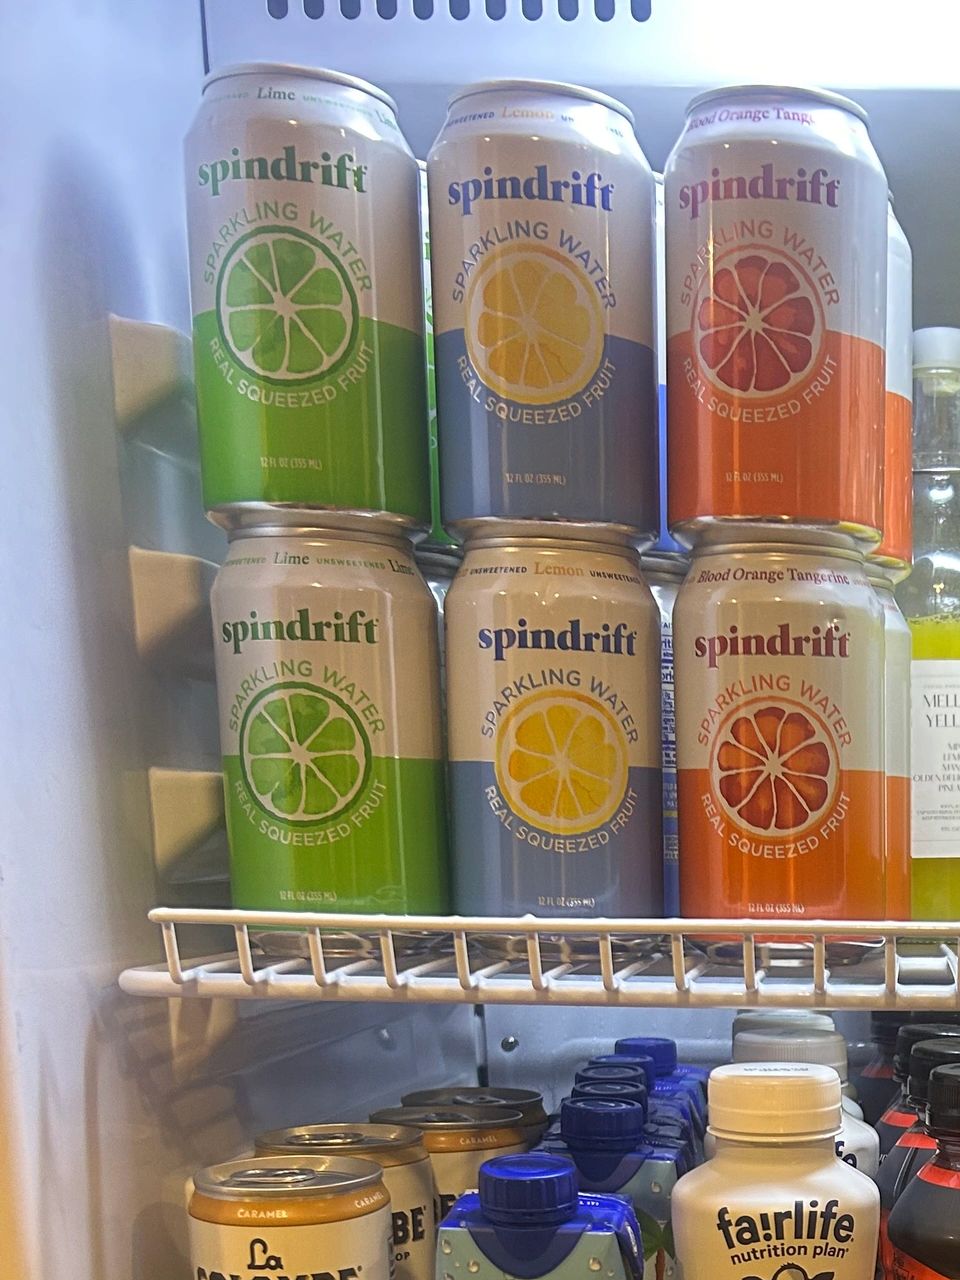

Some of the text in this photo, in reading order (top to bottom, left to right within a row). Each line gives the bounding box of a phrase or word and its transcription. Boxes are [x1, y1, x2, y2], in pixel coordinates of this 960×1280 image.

[257, 86, 296, 102] Lime
[501, 105, 555, 121] Lemon
[717, 107, 771, 124] Orange
[197, 144, 368, 196] spindrift
[448, 165, 615, 217] spindrift
[679, 163, 841, 220] spindrift
[203, 200, 373, 293] SPARKLING WATER
[452, 220, 617, 310] SPARKLING WATER
[680, 219, 840, 307] SPARKLING WATER
[208, 337, 374, 409] REAL SQUEEZED FRUIT
[456, 355, 617, 425] REAL SQUEEZED FRUIT
[684, 357, 838, 423] REAL SQUEEZED FRUIT
[273, 552, 310, 566] Lime
[535, 561, 584, 577] Lemon
[698, 567, 851, 585] Blood Orange Tangerine
[222, 608, 379, 654] spindrift
[478, 618, 638, 661] spindrift
[694, 623, 852, 668] spindrift
[229, 659, 386, 734] SPARKLING WATER
[481, 668, 639, 744] SPARKLING WATER
[697, 673, 852, 748] SPARKLING WATER
[234, 780, 387, 847] REAL SQUEEZED FRUIT
[485, 784, 639, 853] REAL SQUEEZED FRUIT
[701, 792, 852, 859] REAL SQUEEZED FRUIT
[237, 1209, 288, 1219] CARAMEL
[246, 1237, 284, 1271] La
[730, 1243, 846, 1265] nutrition plan
